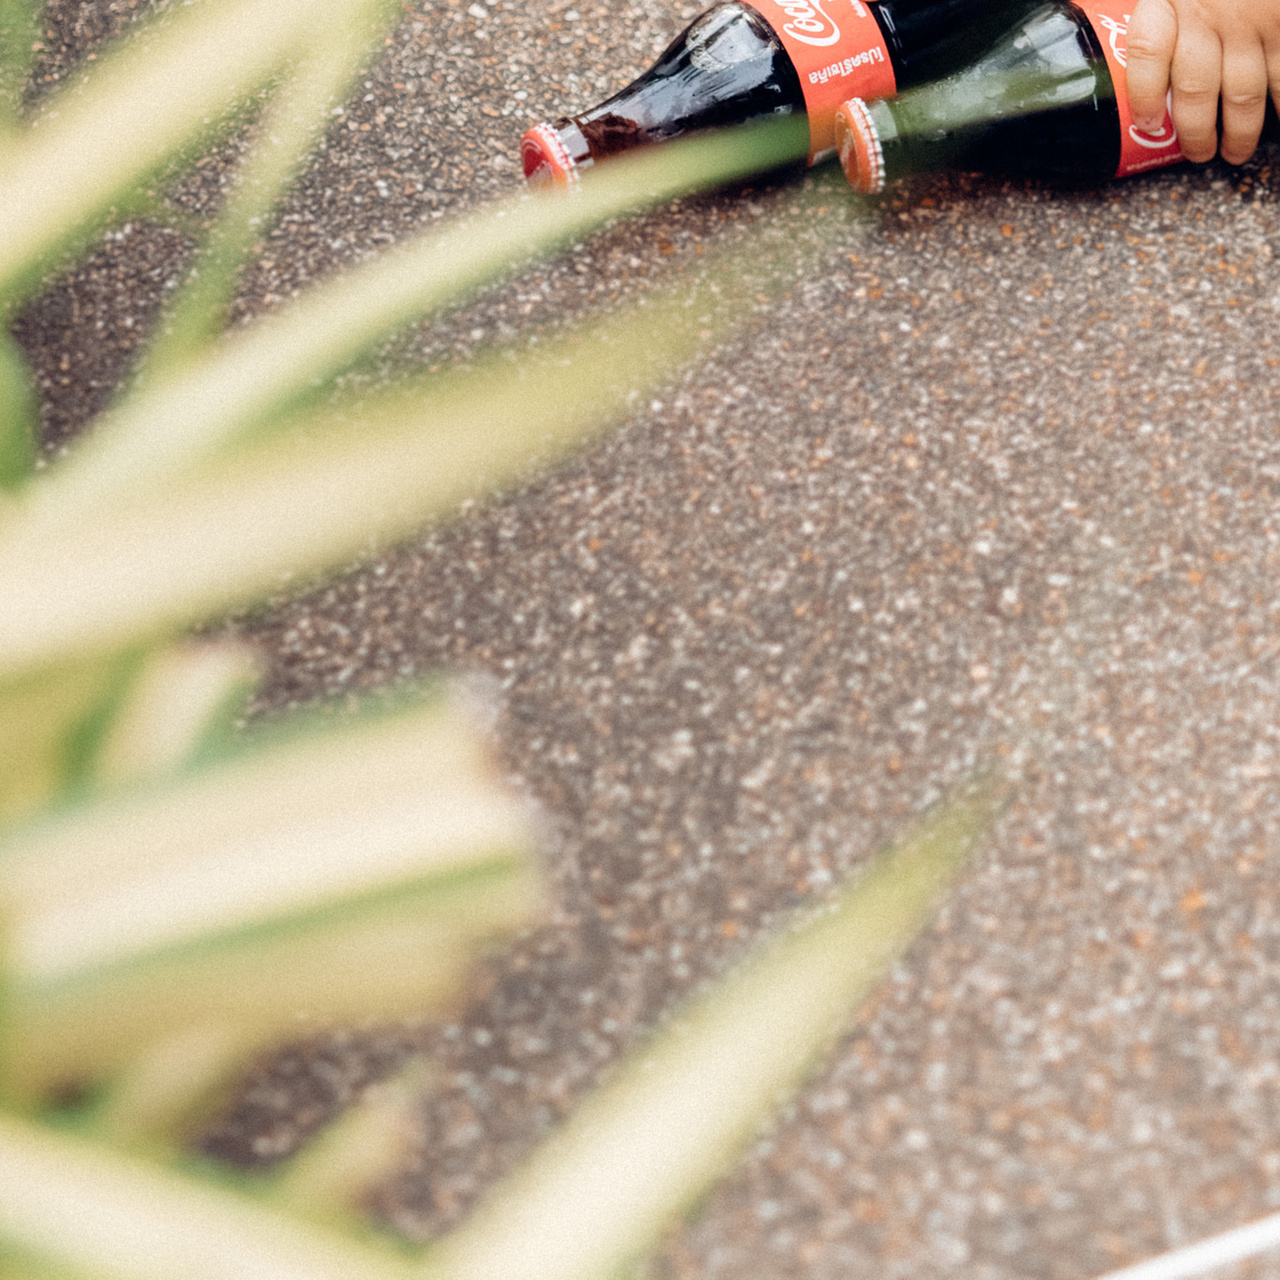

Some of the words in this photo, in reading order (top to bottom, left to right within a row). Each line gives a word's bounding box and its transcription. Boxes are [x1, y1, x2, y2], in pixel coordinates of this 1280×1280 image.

[808, 46, 885, 84] โปรดรีไซเคิล
